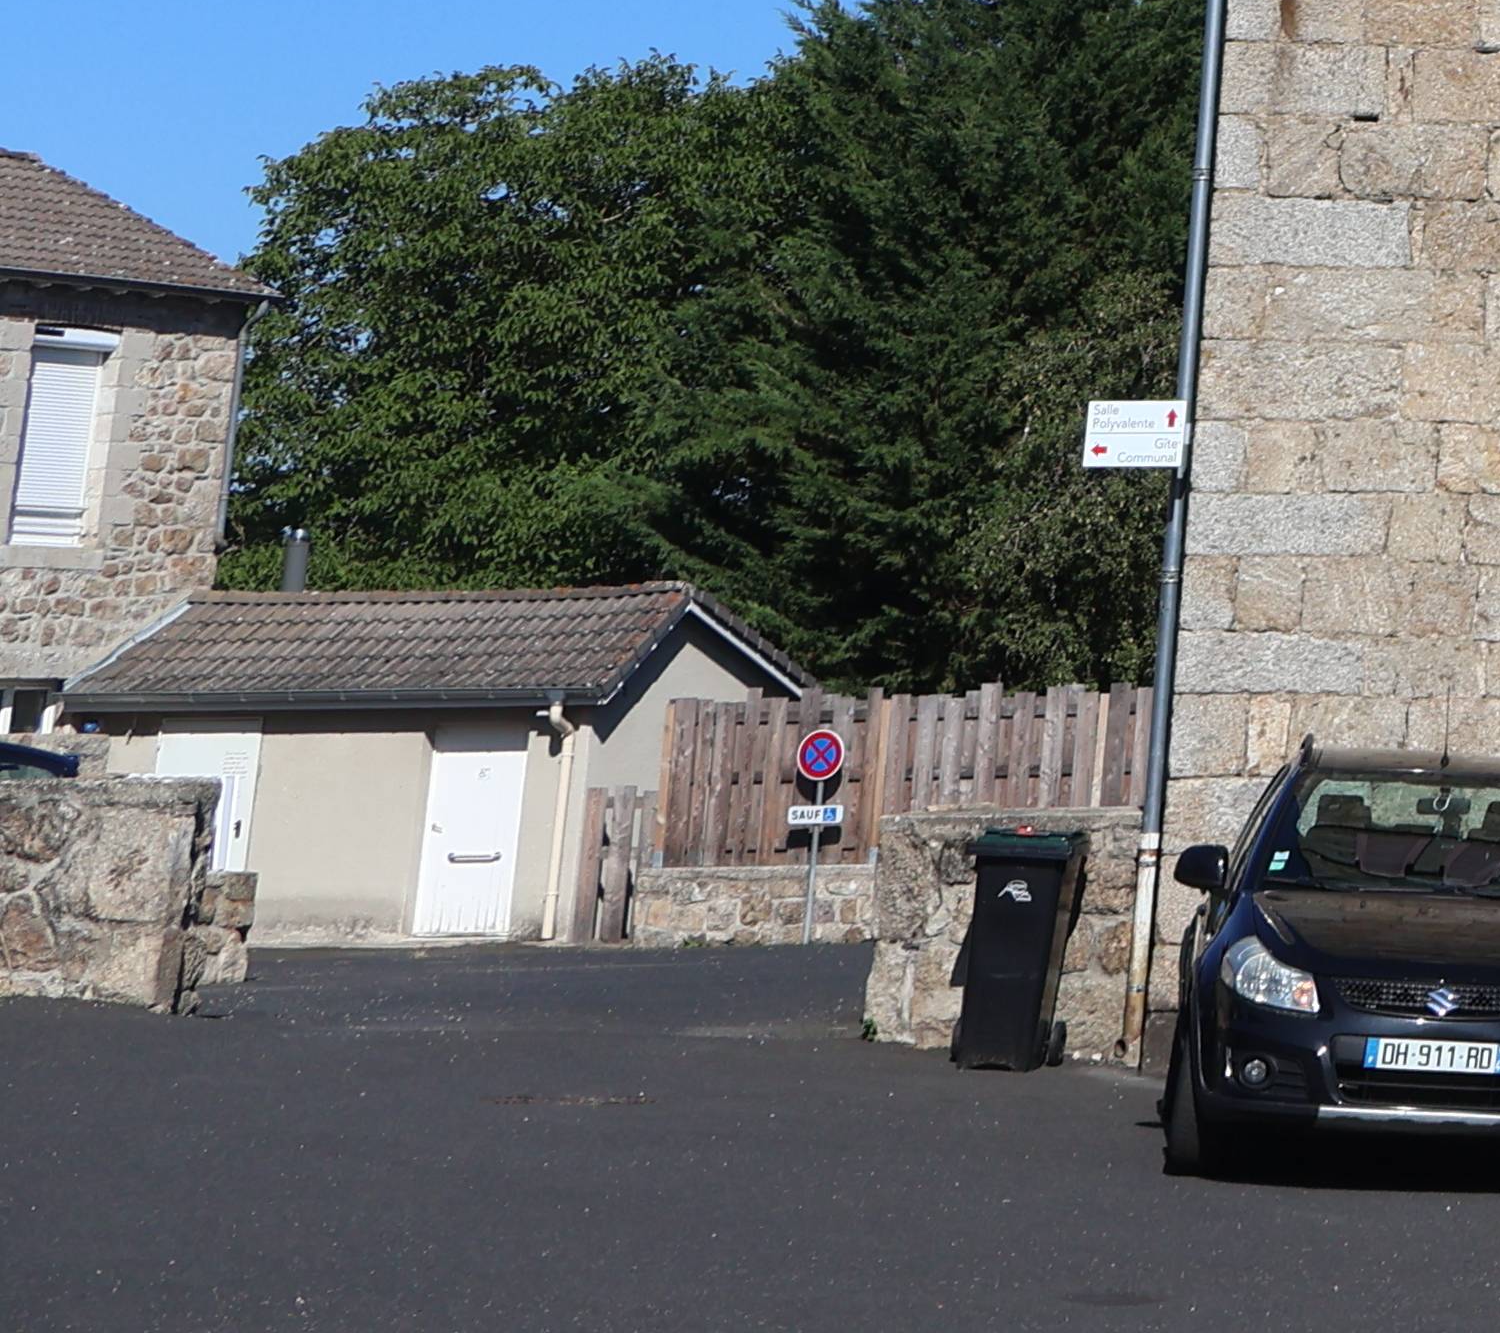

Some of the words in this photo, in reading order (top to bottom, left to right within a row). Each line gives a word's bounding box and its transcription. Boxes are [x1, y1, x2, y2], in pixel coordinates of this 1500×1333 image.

[1094, 404, 1120, 415] Salle
[1092, 417, 1155, 431] Polyvalente
[1117, 451, 1177, 463] Communal
[791, 809, 821, 820] SAUF
